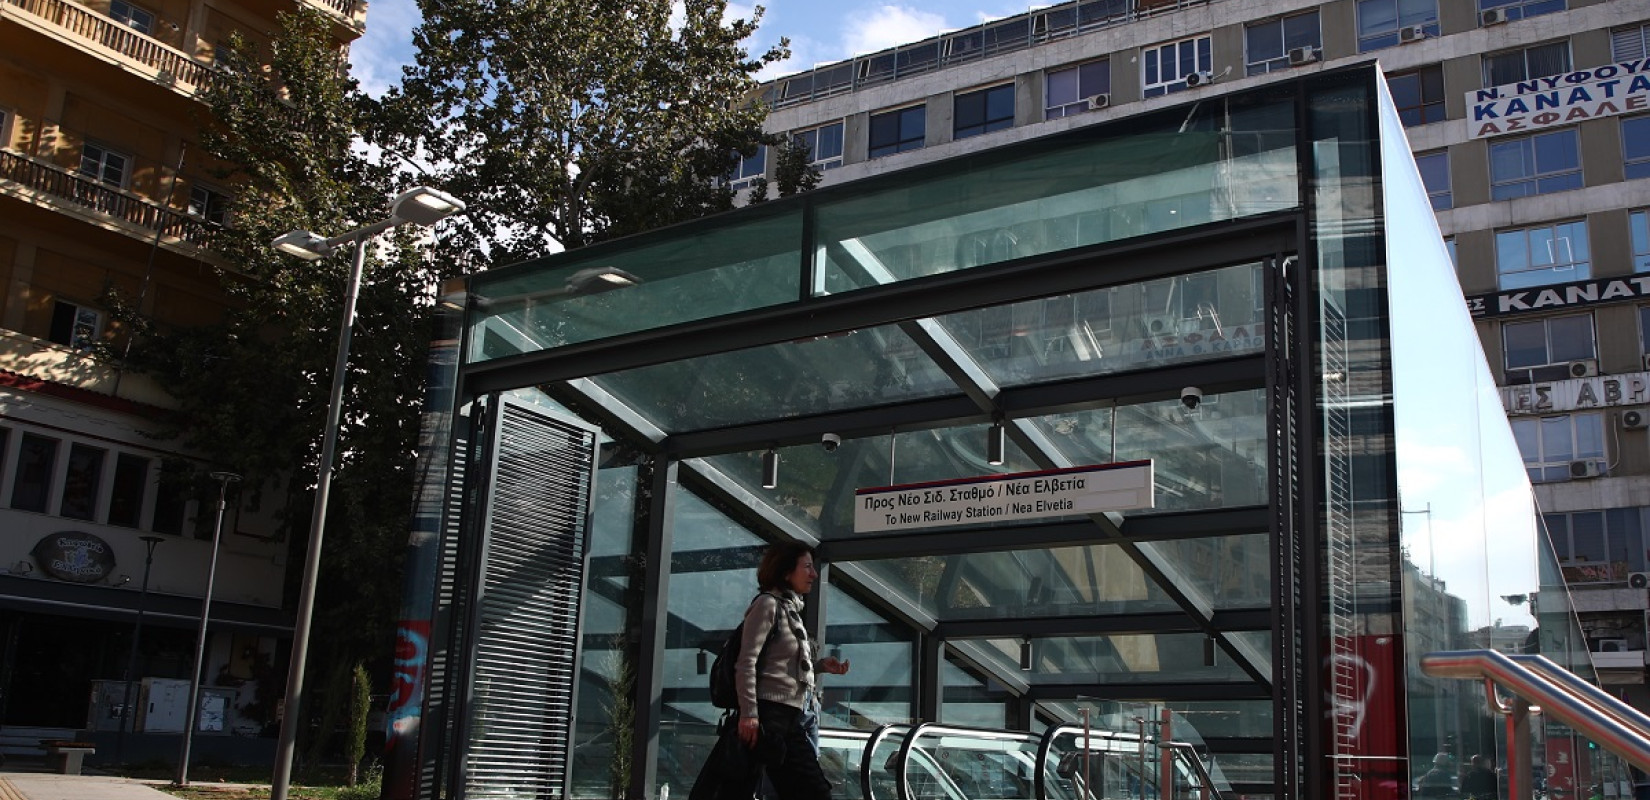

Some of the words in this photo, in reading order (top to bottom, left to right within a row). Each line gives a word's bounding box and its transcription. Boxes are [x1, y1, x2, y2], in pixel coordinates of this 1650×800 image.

[1473, 75, 1650, 121] ΚΑΝΑΤΑ
[1476, 87, 1505, 102] Ν.
[1477, 95, 1648, 136] ΑΣΦΑΛΕ
[864, 496, 895, 512] Προς
[898, 492, 921, 506] Νέο
[923, 490, 946, 504] Σιδ.
[949, 484, 995, 502] Σταθμό
[997, 483, 1003, 497] /
[1005, 482, 1031, 496] Νέα
[1034, 476, 1086, 495] Ελβετία
[885, 513, 897, 526] To
[900, 512, 921, 524] New
[923, 509, 963, 522] Railway
[966, 504, 1002, 518] Station
[1004, 503, 1010, 515] /
[1012, 501, 1032, 514] Nea
[1036, 498, 1073, 512] Elvetia
